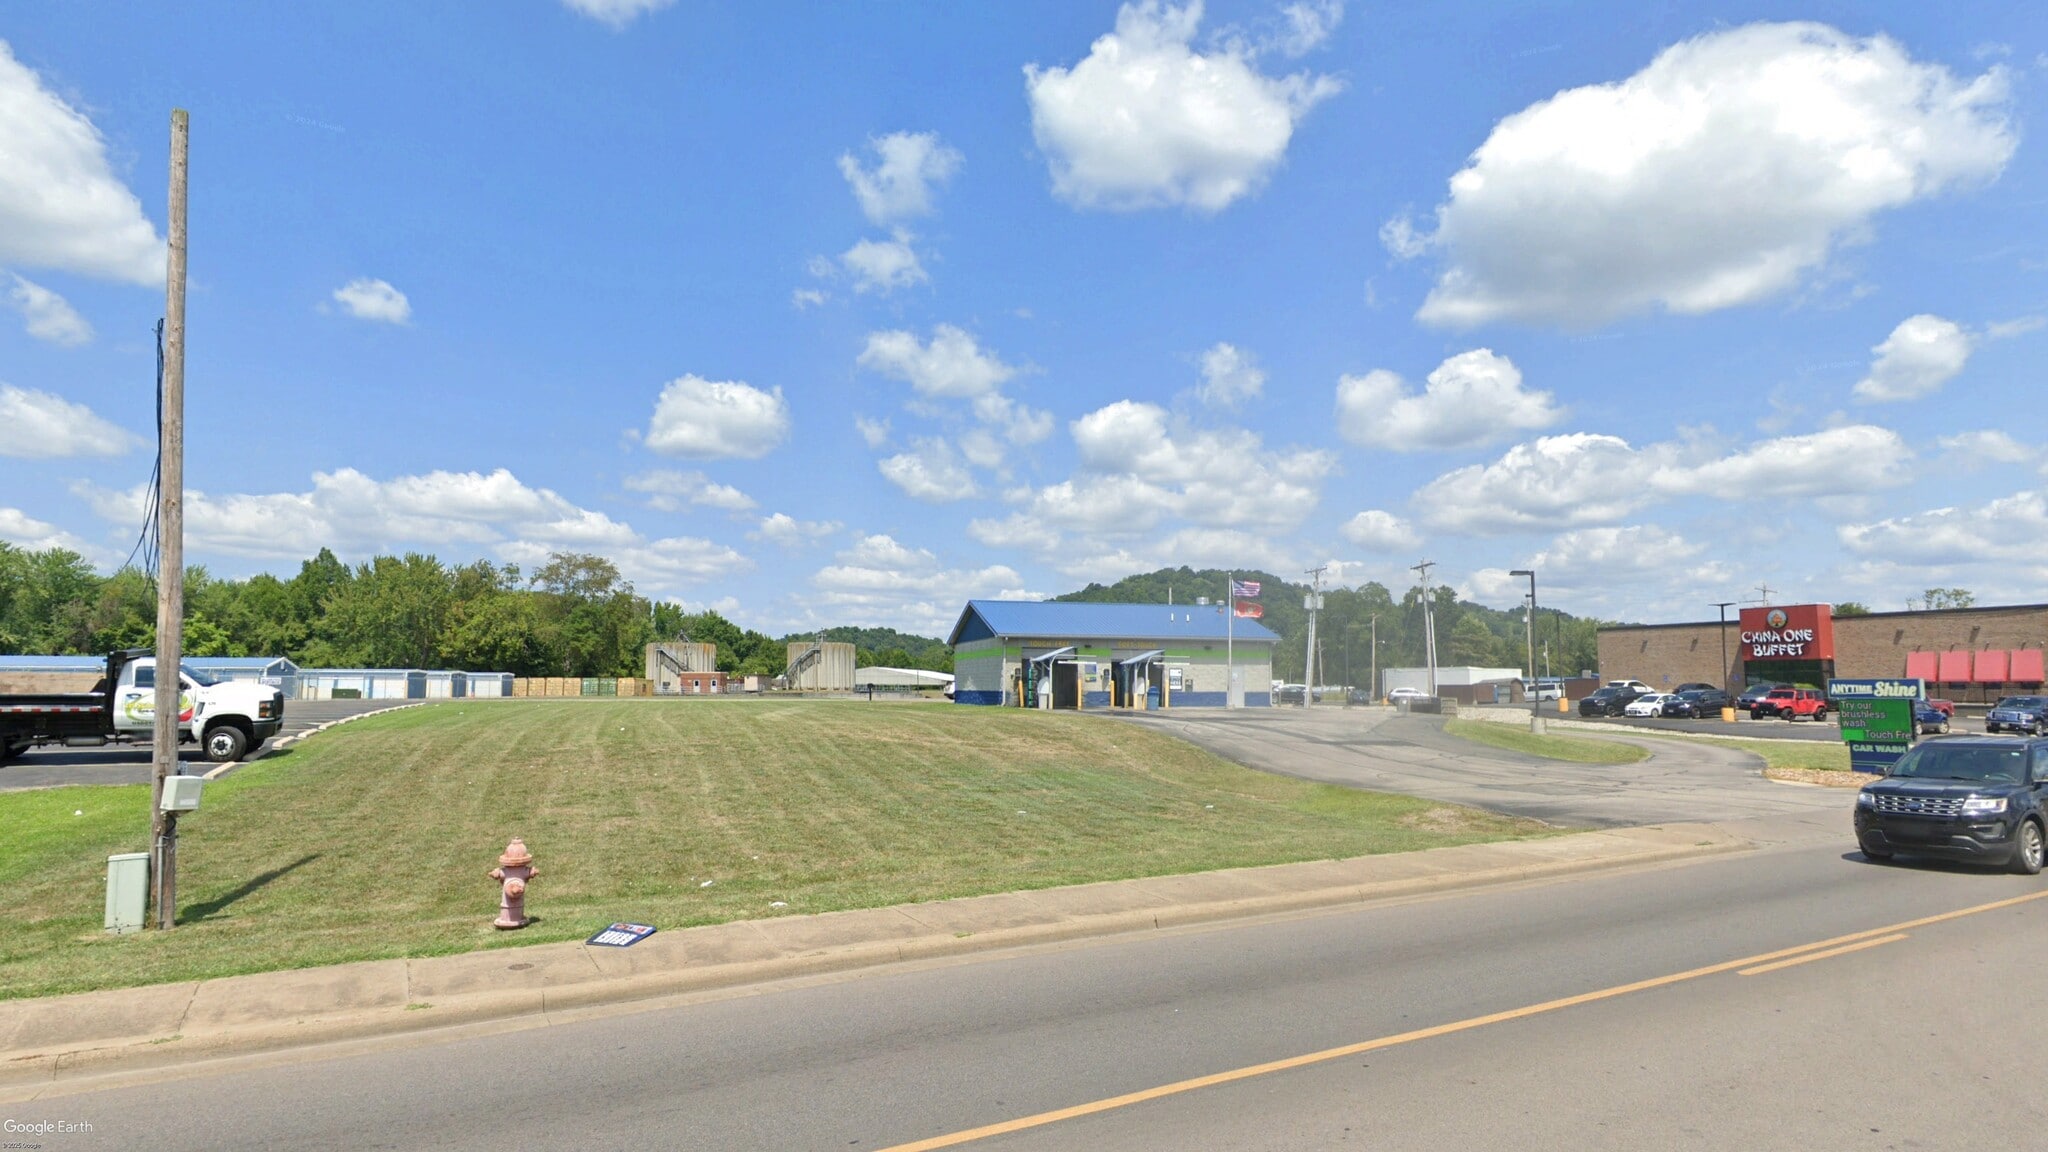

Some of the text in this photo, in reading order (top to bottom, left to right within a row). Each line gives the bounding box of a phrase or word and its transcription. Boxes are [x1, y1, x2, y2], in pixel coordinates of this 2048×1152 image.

[1741, 629, 1813, 643] CHINA ONE
[1753, 643, 1804, 657] BUFFET
[1831, 681, 1917, 697] ANYTIME Shine
[1841, 701, 1872, 711] Try our
[1841, 710, 1886, 719] brushless
[1842, 719, 1866, 727] wash
[1865, 730, 1894, 739] Touch
[1852, 744, 1907, 753] CAR WASH
